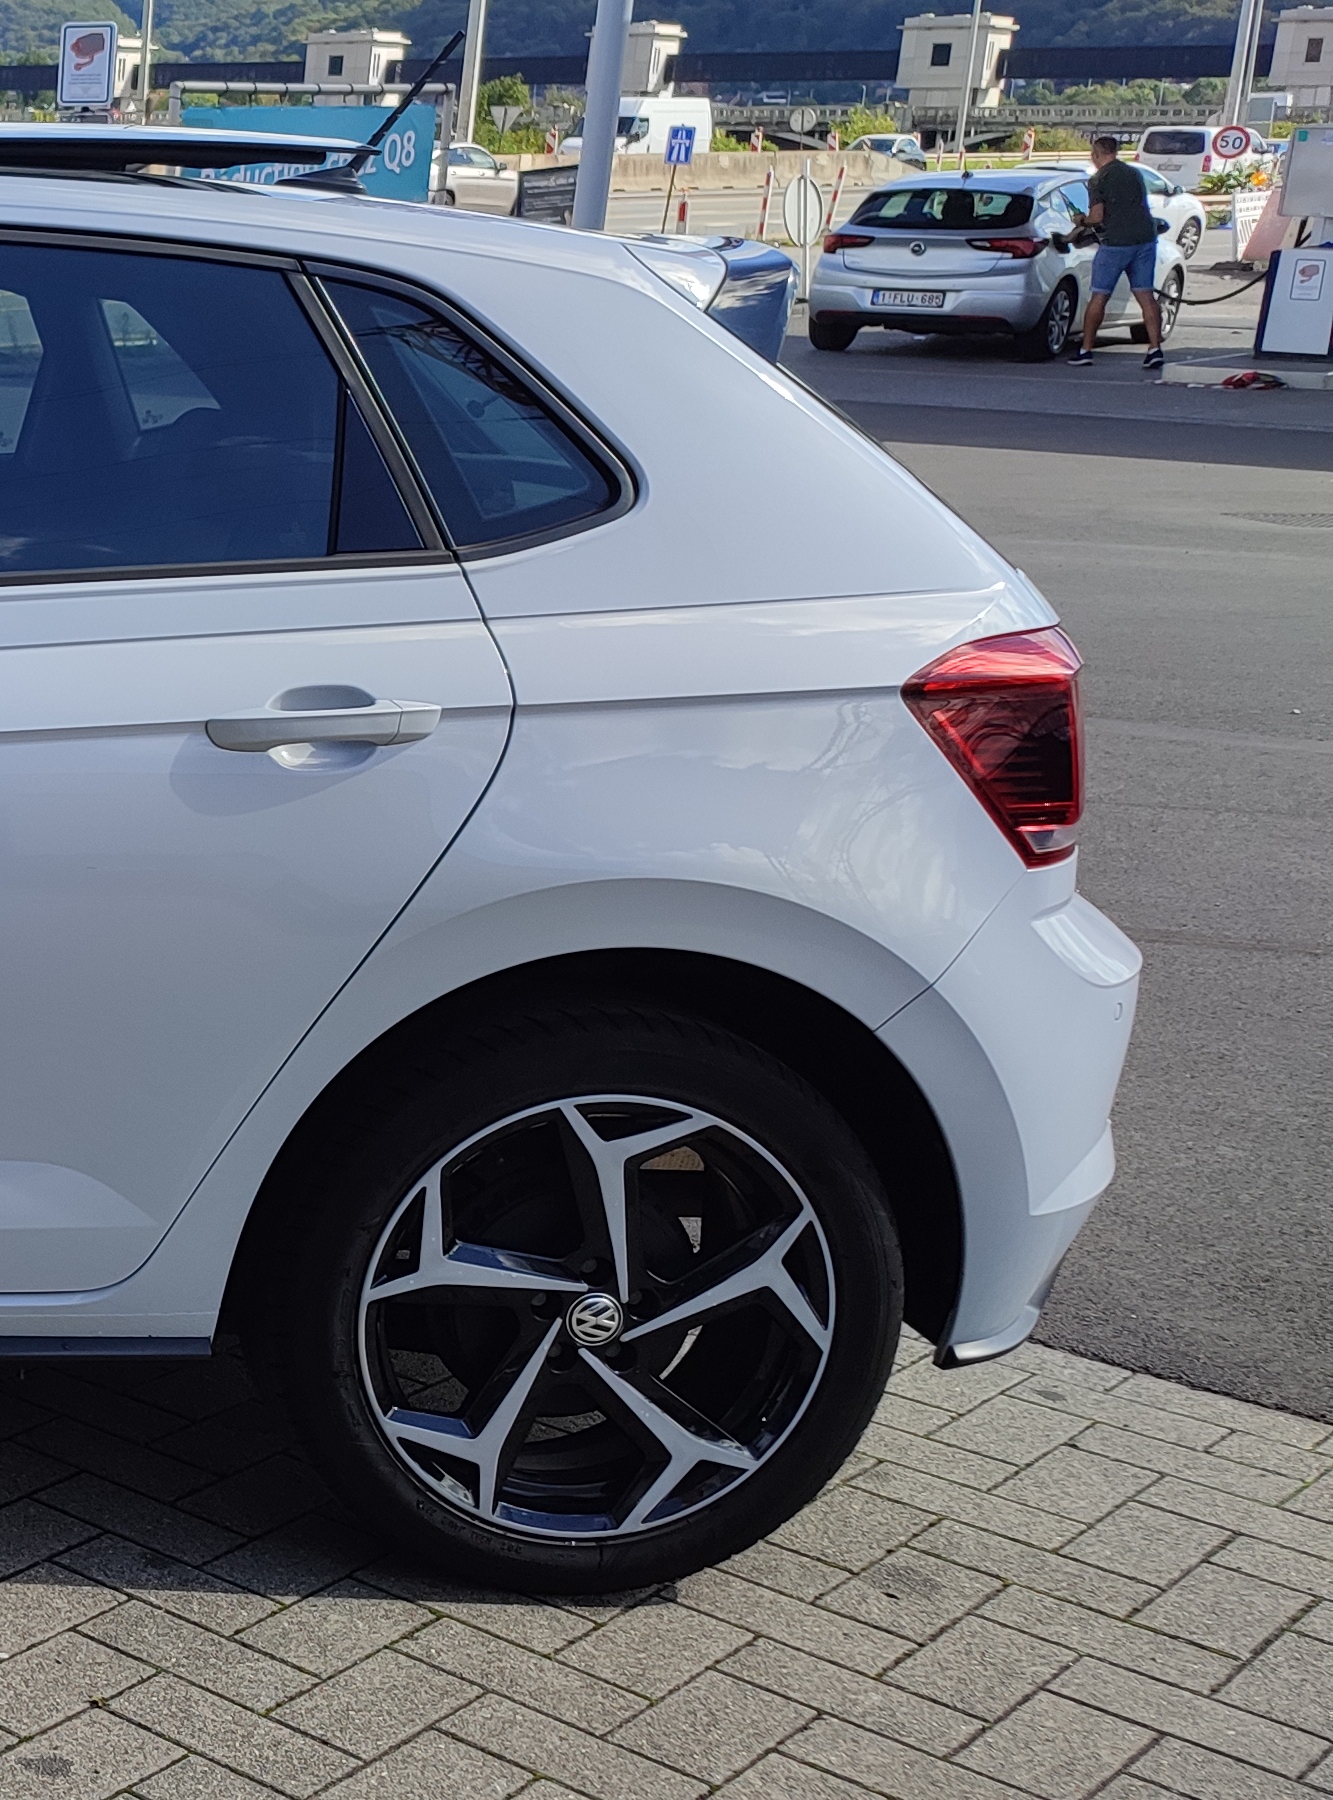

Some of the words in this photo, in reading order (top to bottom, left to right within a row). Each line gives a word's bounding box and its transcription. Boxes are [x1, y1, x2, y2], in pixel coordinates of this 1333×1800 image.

[200, 163, 318, 185] ductio
[384, 130, 415, 174] Q8
[1219, 135, 1244, 150] 50
